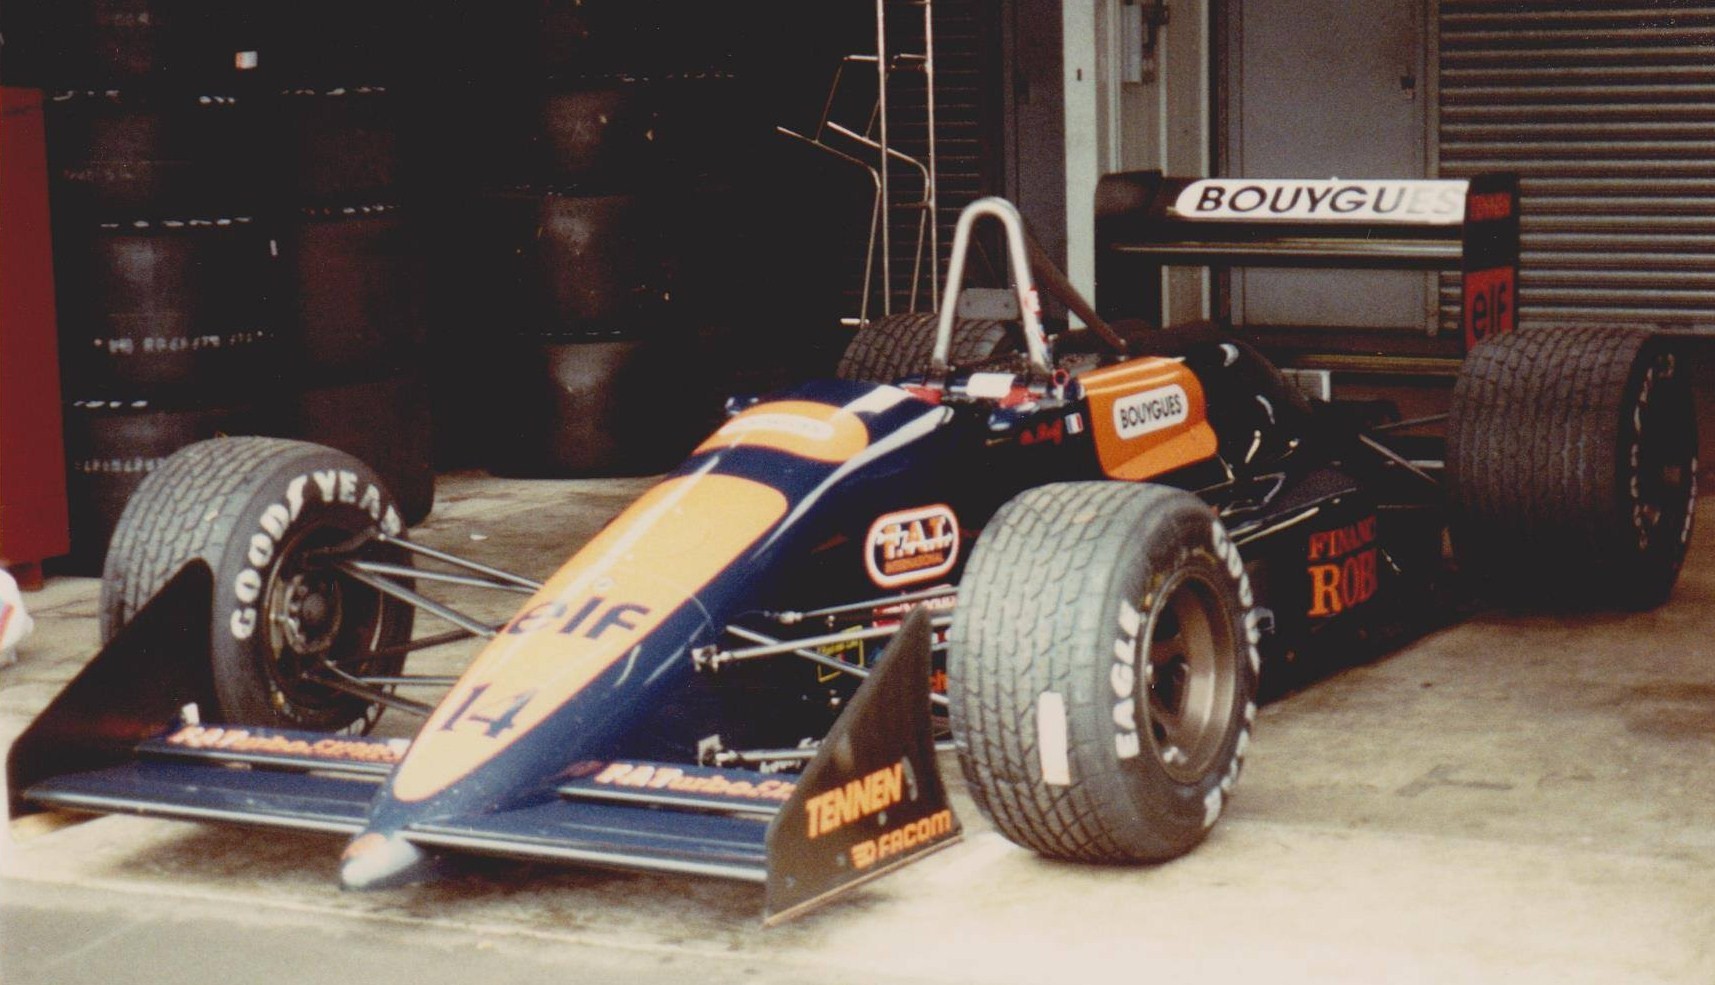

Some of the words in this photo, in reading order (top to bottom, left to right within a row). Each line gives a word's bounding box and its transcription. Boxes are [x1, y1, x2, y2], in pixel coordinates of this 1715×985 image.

[1195, 185, 1466, 214] BOUYGUES
[1120, 394, 1183, 429] BOUYGUES
[507, 596, 650, 640] elf
[438, 682, 540, 738] 14
[804, 763, 904, 840] TENNEN
